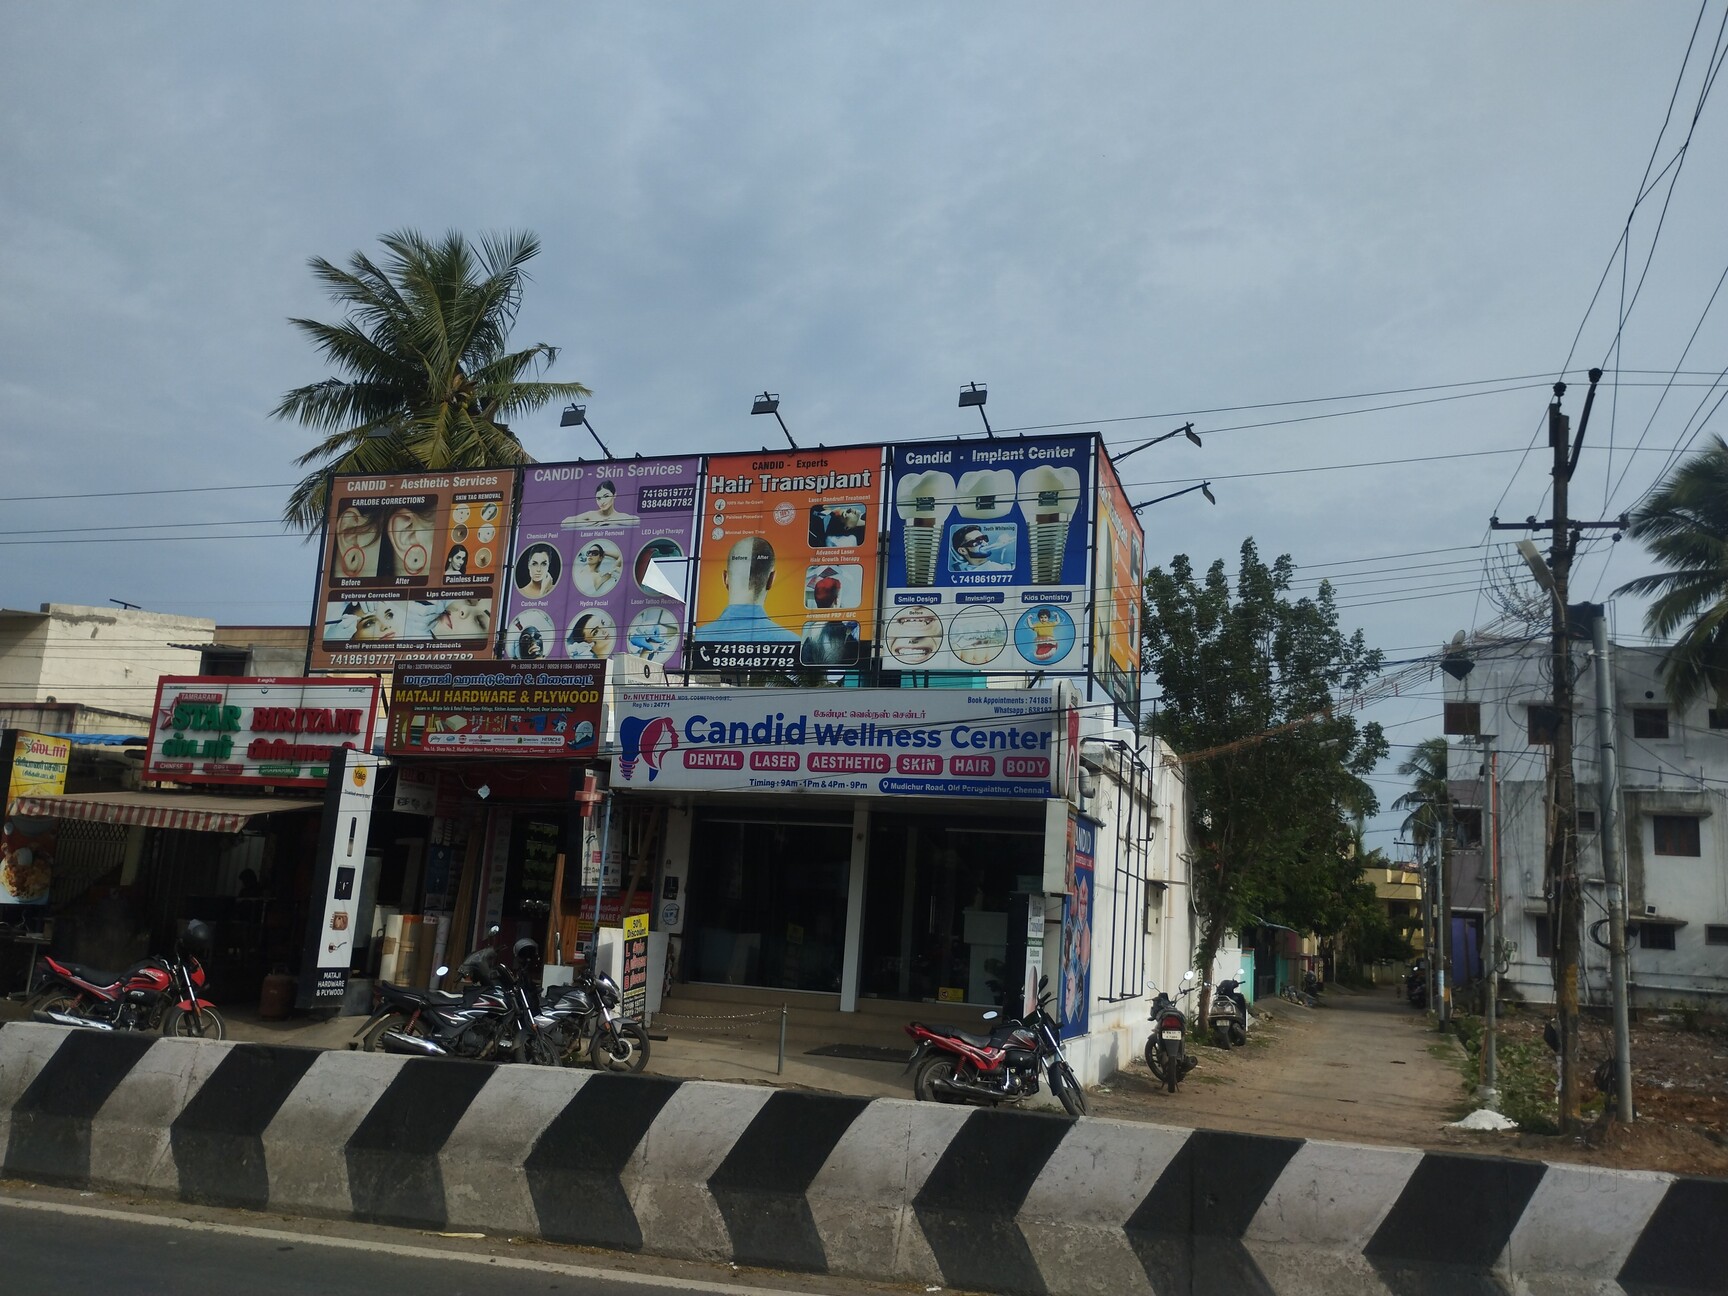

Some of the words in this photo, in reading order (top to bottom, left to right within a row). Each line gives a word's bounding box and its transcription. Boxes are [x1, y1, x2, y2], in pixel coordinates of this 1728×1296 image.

[906, 451, 951, 464] Candid
[972, 448, 1024, 464] Implant
[1028, 446, 1075, 459] Center
[752, 461, 784, 470] CANDID
[796, 459, 828, 469] Experts
[534, 468, 584, 482] CANDID
[596, 466, 623, 478] Skin
[628, 464, 683, 477] Services
[347, 480, 386, 492] CANDID
[400, 477, 450, 489] Aesthetic
[452, 476, 498, 487] Services
[711, 475, 752, 494] Hair
[759, 470, 871, 494] Transplant
[642, 488, 694, 498] 7418619777
[381, 497, 425, 505] CORRECTIONS
[641, 498, 692, 508] 9384487782
[959, 575, 1013, 584] 7418619777
[917, 595, 938, 603] Design
[714, 644, 796, 654] 7418619777
[330, 654, 395, 665] 7418619777
[712, 658, 794, 667] 9384487782
[404, 673, 452, 687] மாதாஜி
[453, 673, 521, 687] ஹார்டுவேர்
[524, 675, 535, 685] &
[396, 691, 440, 703] MATAJI
[444, 691, 516, 703] HARDWARE
[522, 692, 530, 703] &
[534, 690, 599, 704] PLYWOOD
[983, 697, 1024, 705] Appointments
[173, 704, 241, 732] STAR
[250, 707, 363, 735] BIRIYANI
[684, 713, 807, 745] Candid
[815, 723, 941, 747] Wellness
[950, 725, 1052, 750] Center
[31, 739, 67, 758] ஸ்டார்
[689, 754, 737, 766] DENTAL
[755, 755, 796, 768] LASER
[812, 756, 884, 770] AESTHETIC
[902, 758, 936, 770] SKIN
[956, 760, 990, 773] HAIR
[1006, 760, 1045, 773] BODY
[354, 770, 366, 780] Yale
[750, 779, 775, 788] Timing
[890, 782, 924, 791] Mudichur
[1013, 786, 1044, 794] Chennai
[632, 918, 642, 928] 50%
[627, 928, 646, 938] Discount
[317, 980, 345, 988] HARDWARE
